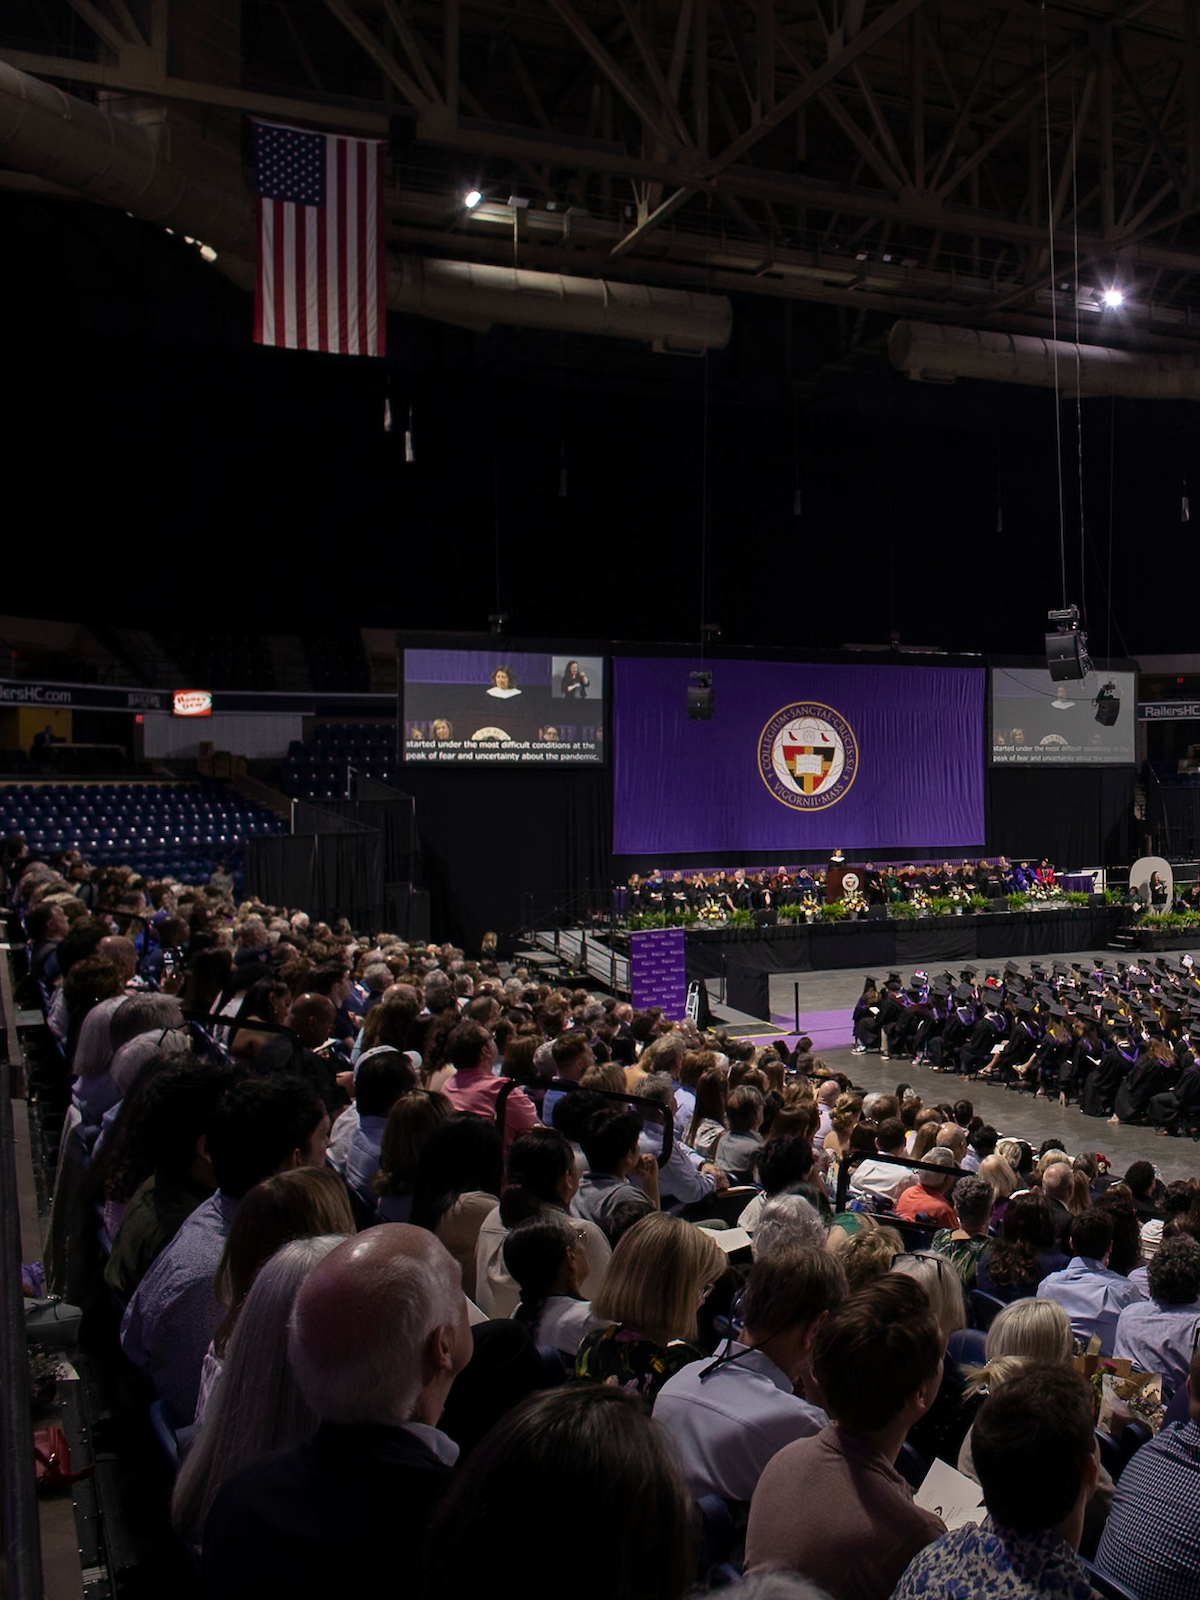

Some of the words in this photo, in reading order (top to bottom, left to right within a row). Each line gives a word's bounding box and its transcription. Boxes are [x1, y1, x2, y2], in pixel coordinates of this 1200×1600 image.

[405, 740, 436, 749] started
[437, 740, 462, 749] under
[463, 740, 477, 749] the
[479, 740, 499, 749] most
[501, 740, 531, 749] difficult
[531, 741, 571, 750] conditions
[573, 742, 581, 750] at
[582, 741, 595, 750] the
[762, 714, 789, 770] COLLEGIUM
[790, 706, 832, 721] SANCTAE
[833, 719, 855, 755] CRUCIS
[405, 751, 426, 761] peak
[428, 751, 438, 760] of
[438, 751, 456, 760] fear
[457, 751, 473, 760] and
[475, 751, 520, 762] uncertainty
[521, 752, 544, 761] about
[545, 752, 558, 761] the
[560, 752, 600, 762] pandemic.
[773, 782, 818, 807] VIGORNII
